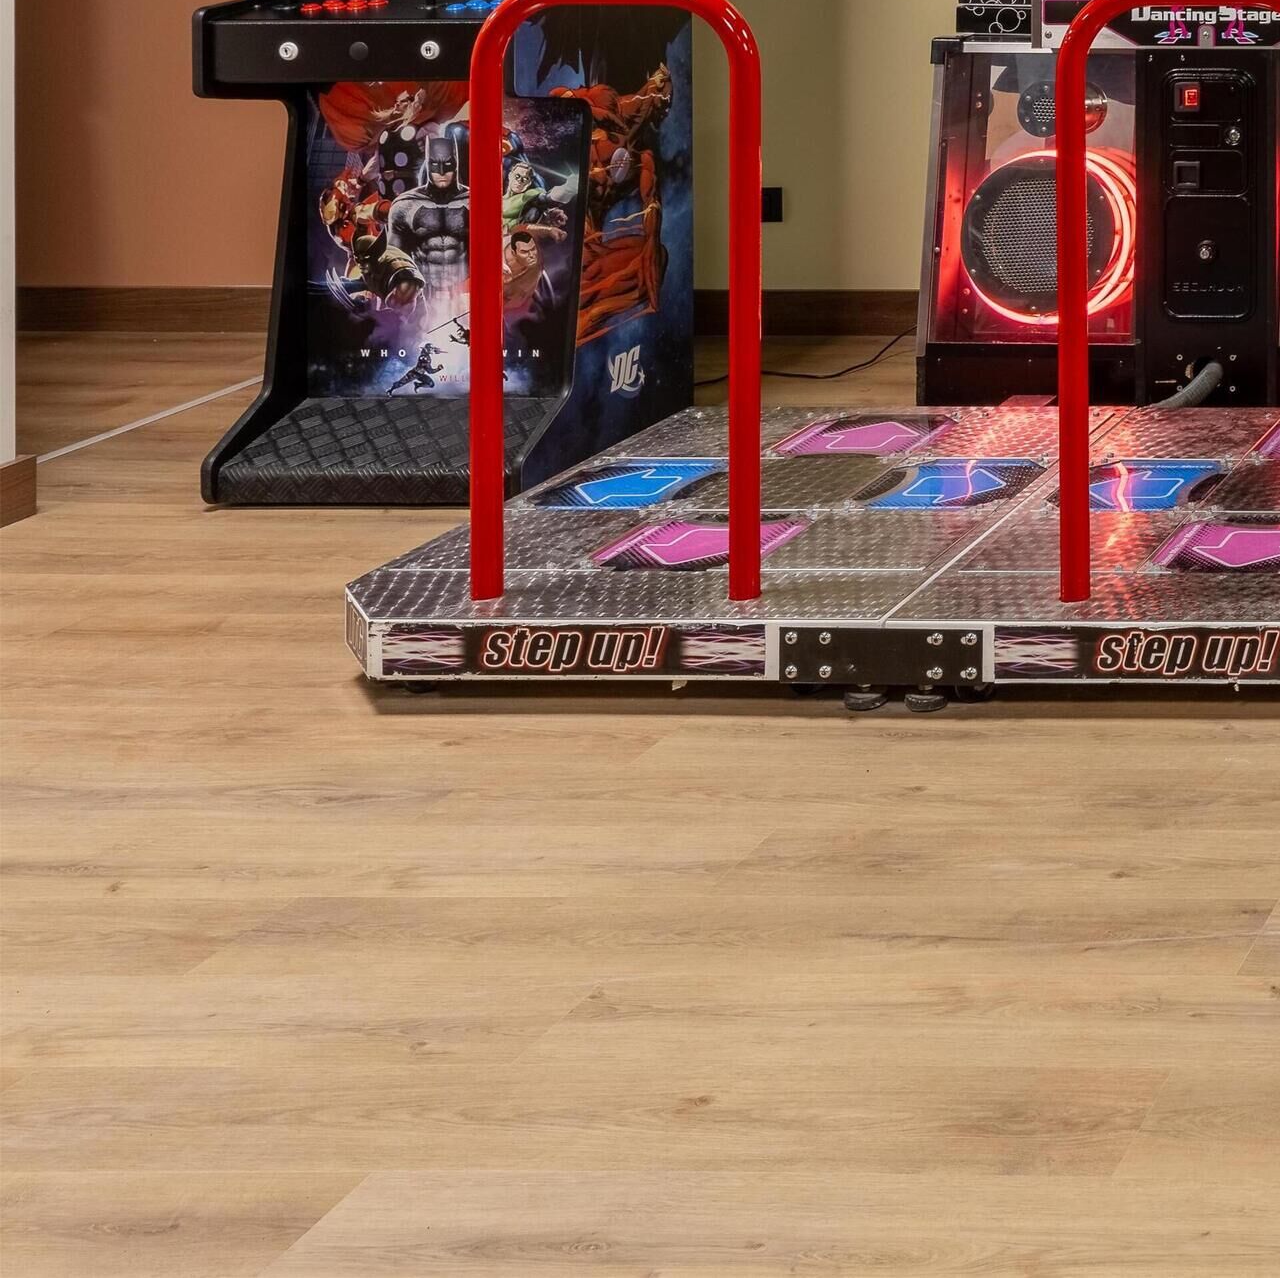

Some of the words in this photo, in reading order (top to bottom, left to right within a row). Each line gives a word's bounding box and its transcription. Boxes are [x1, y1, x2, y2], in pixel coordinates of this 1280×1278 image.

[1131, 6, 1217, 25] Dancing
[360, 349, 406, 358] WHO
[483, 626, 581, 672] step
[586, 626, 668, 672] up!
[1096, 633, 1201, 676] step
[1202, 630, 1280, 676] up!
